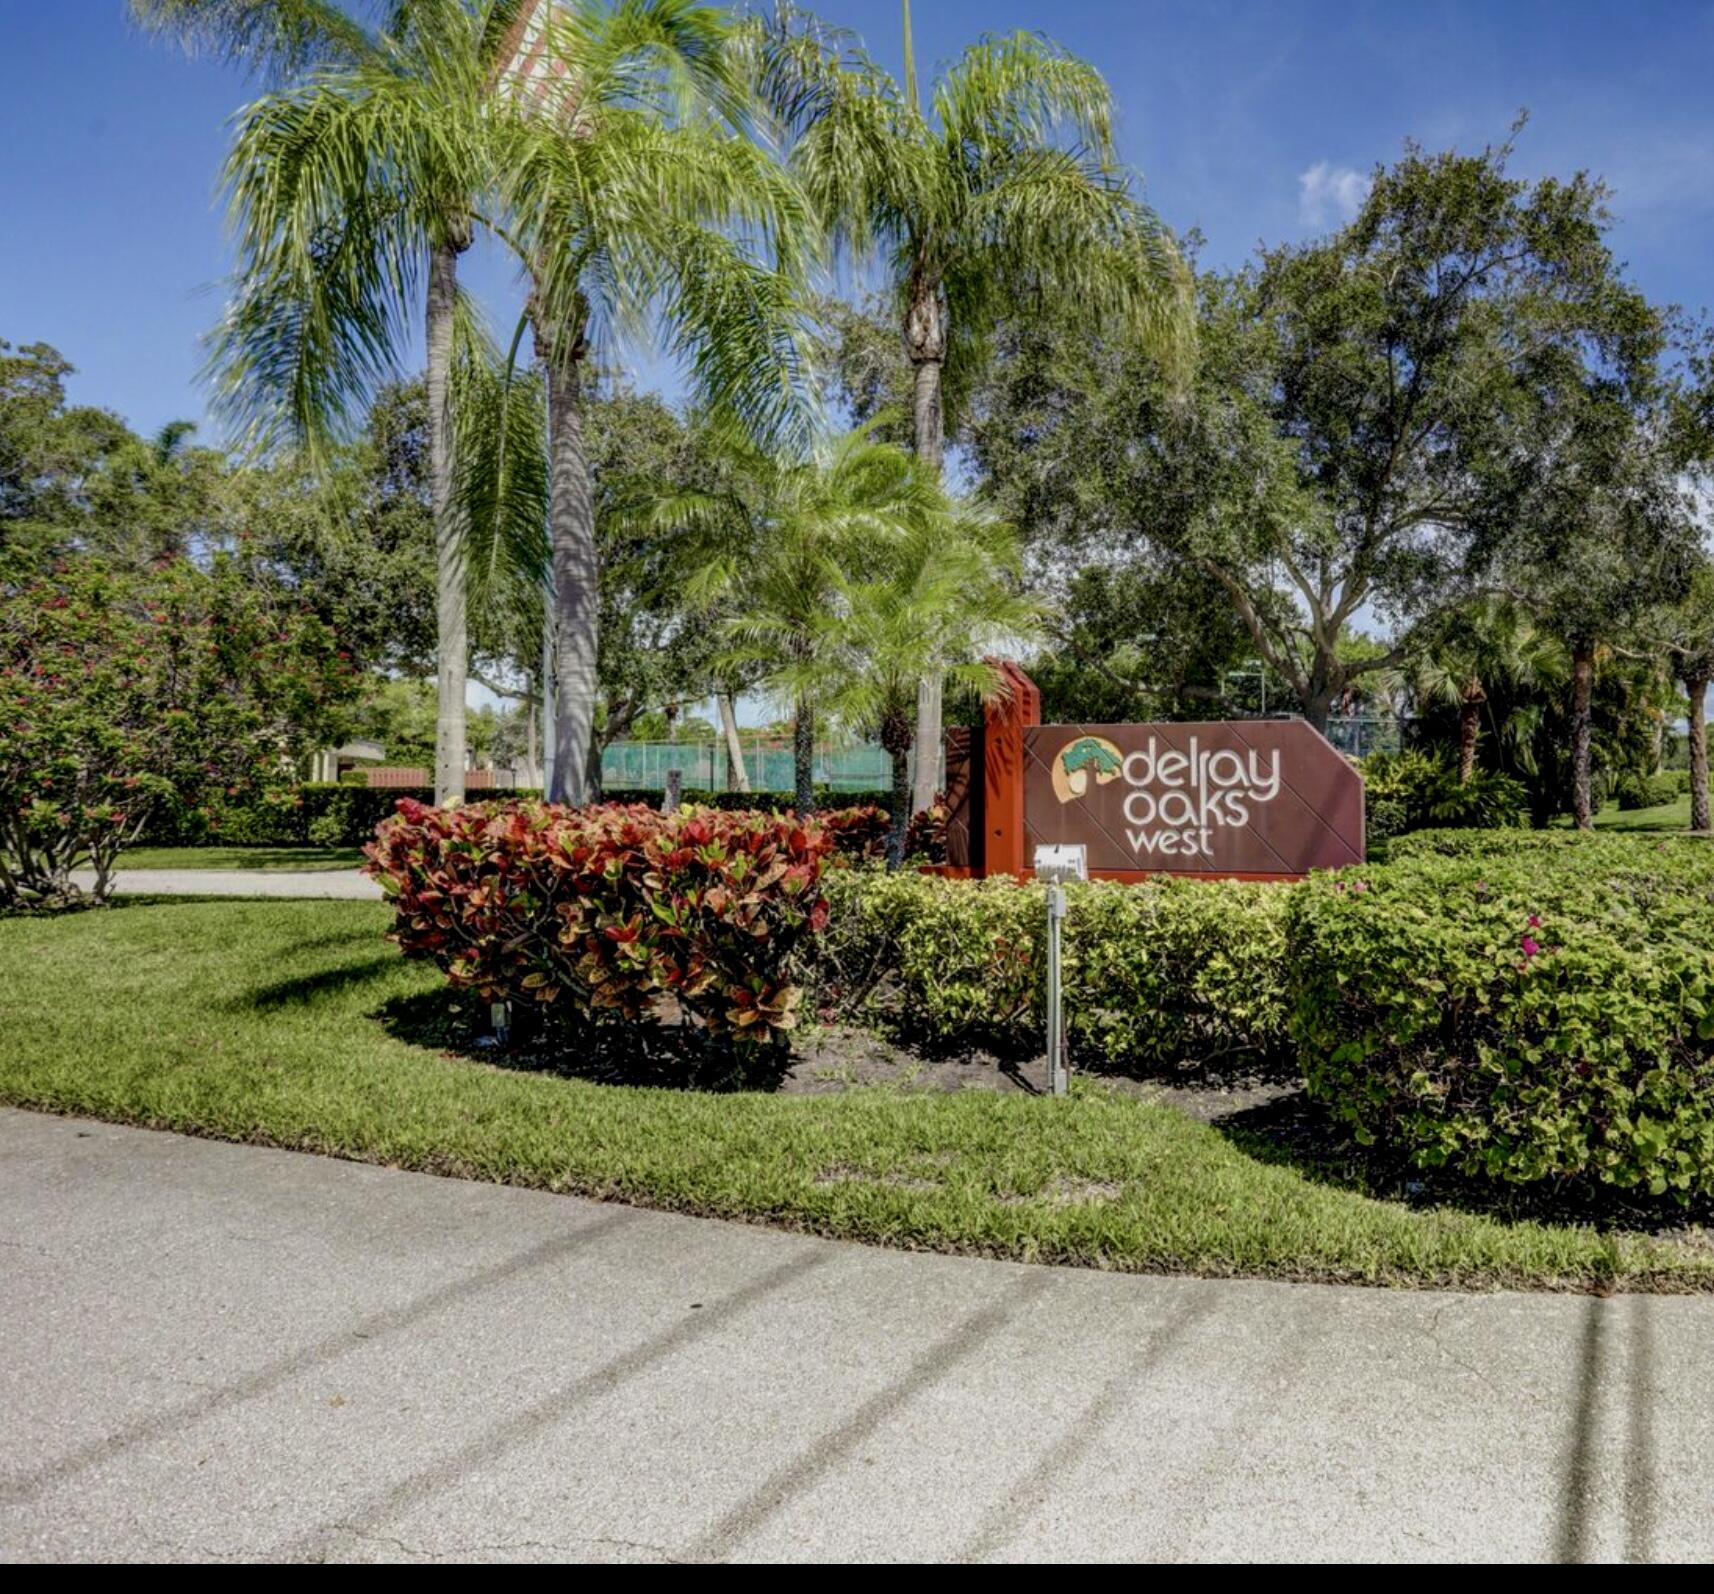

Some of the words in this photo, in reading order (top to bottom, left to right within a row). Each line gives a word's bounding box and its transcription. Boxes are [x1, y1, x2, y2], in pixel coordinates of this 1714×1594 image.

[1122, 736, 1280, 801] delray
[1123, 787, 1249, 827] oaks
[1125, 828, 1214, 856] west
